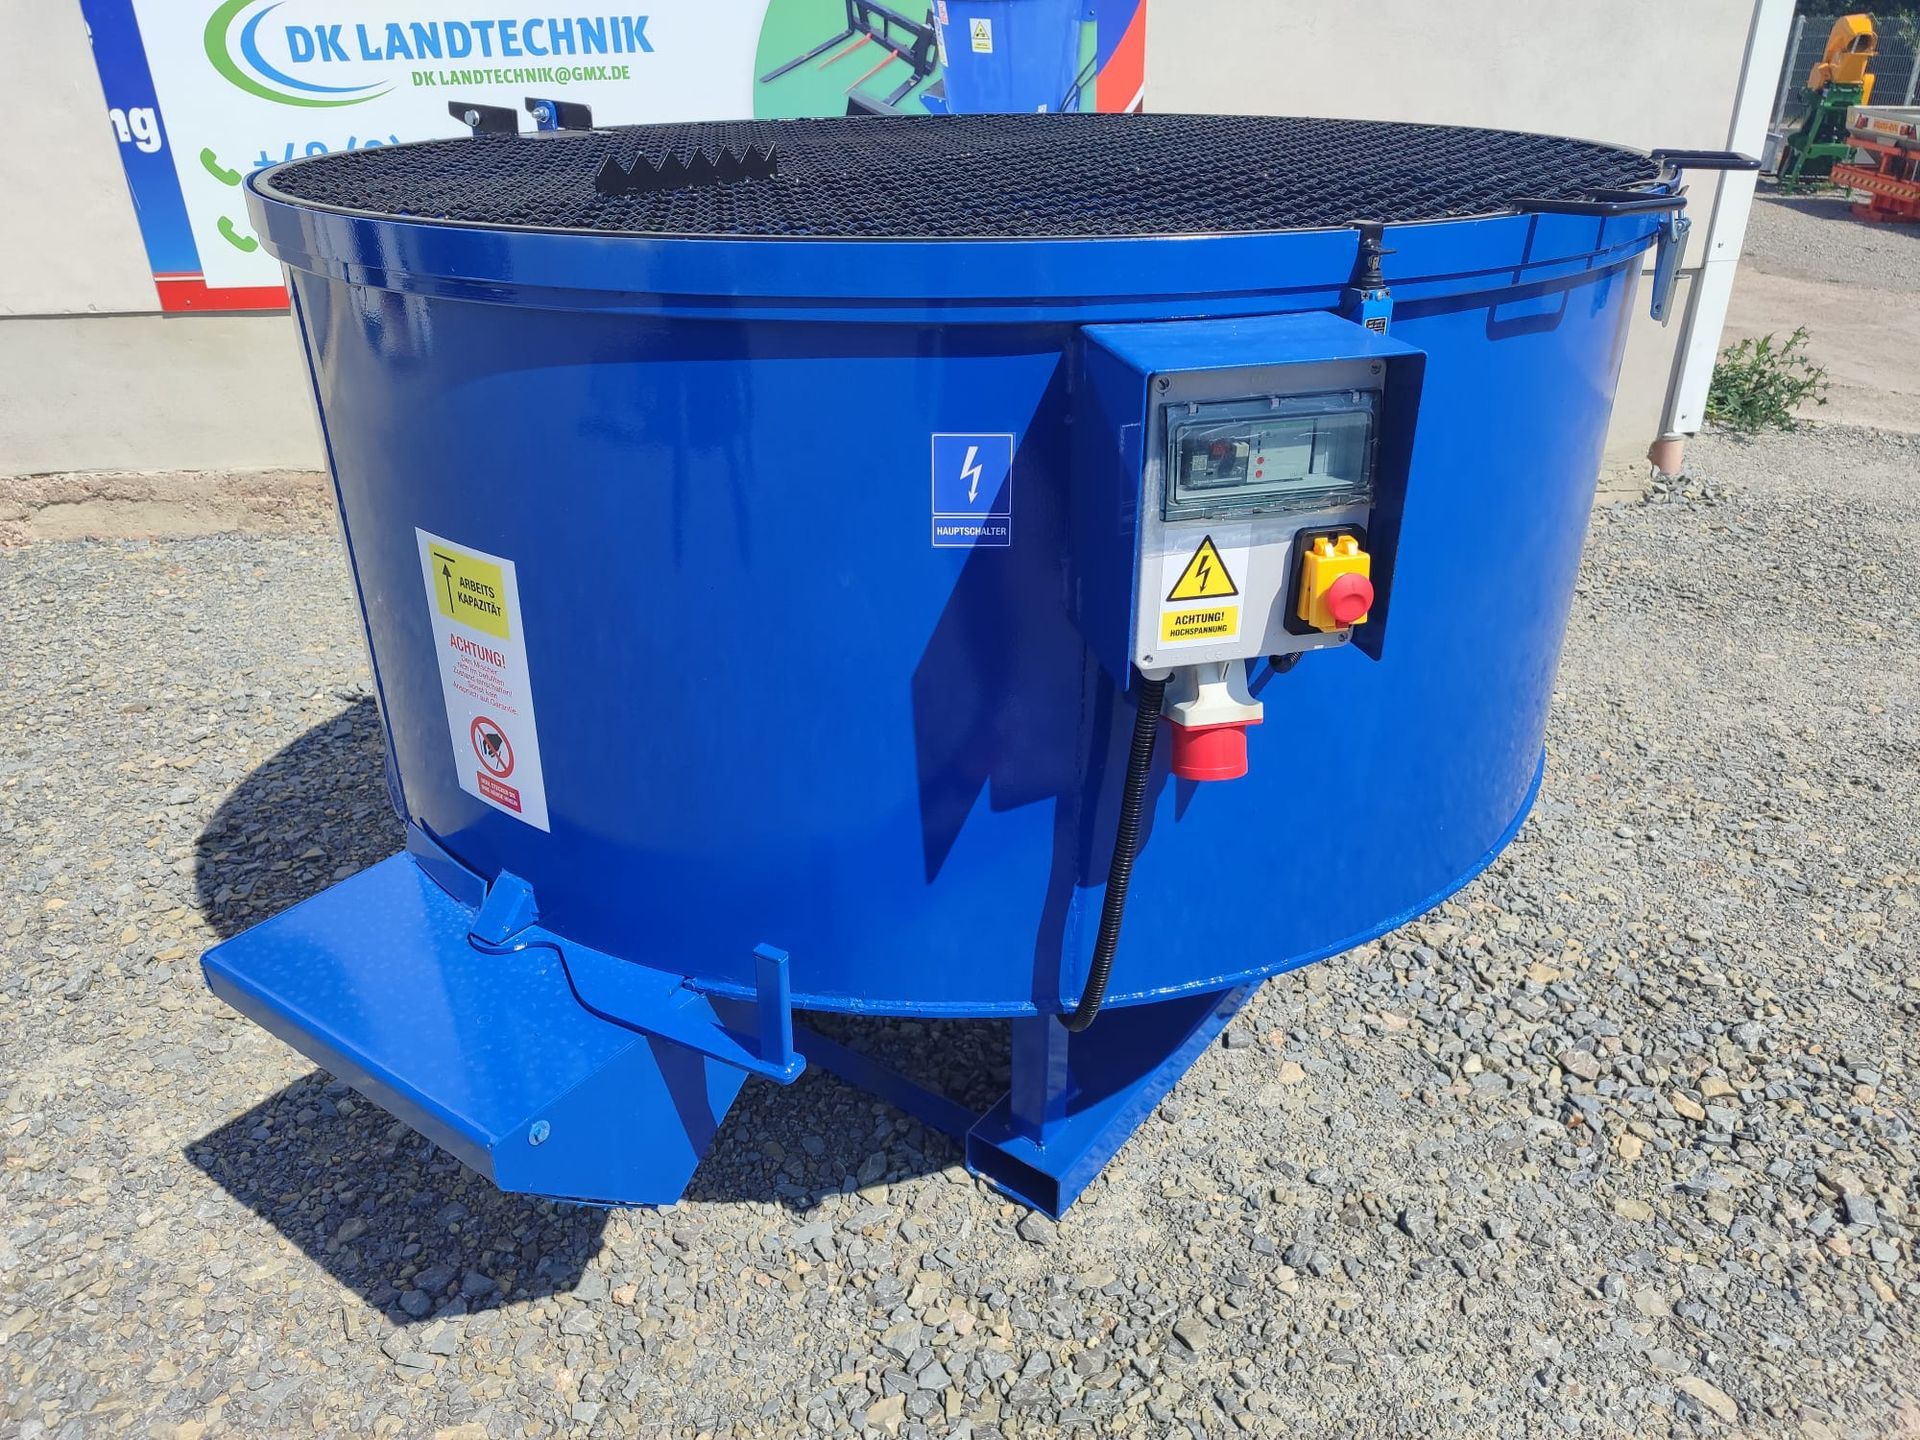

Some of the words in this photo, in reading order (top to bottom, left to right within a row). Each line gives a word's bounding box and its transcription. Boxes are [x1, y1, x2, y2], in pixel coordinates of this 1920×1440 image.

[285, 25, 351, 63] DK
[356, 15, 655, 61] LANDTECHNIK
[412, 71, 436, 87] DK
[439, 65, 630, 86] LANDTECHNIK@GMX.DE
[936, 526, 1007, 536] HAUPTSCHALTER
[459, 576, 495, 599] ARBEITS
[457, 590, 501, 617] KAPAZITÄT
[1175, 612, 1225, 626] ACHTUNG!
[1170, 624, 1227, 637] HOCHSPANNUNG
[450, 633, 506, 669] ACHTUNG!
